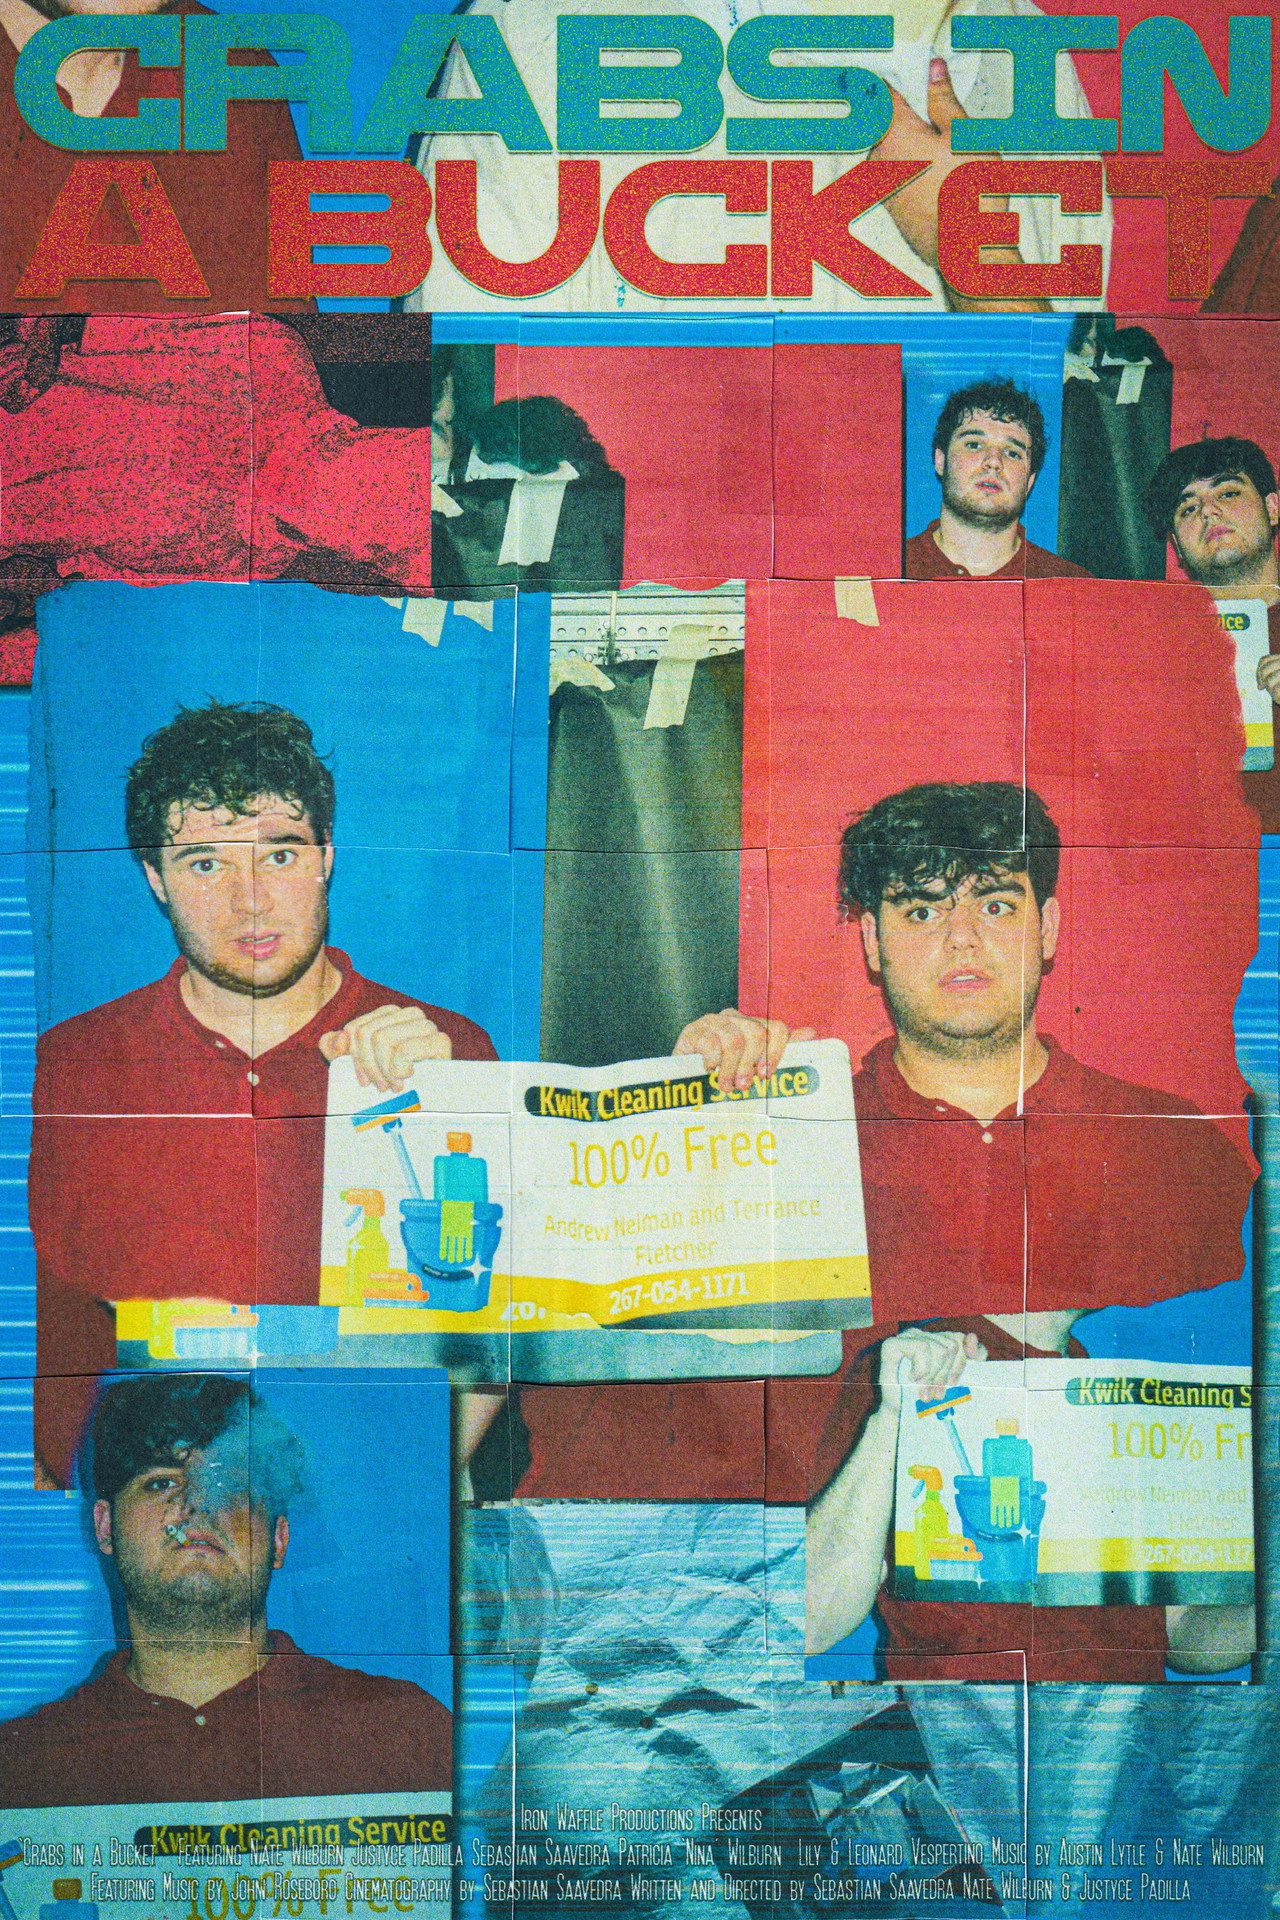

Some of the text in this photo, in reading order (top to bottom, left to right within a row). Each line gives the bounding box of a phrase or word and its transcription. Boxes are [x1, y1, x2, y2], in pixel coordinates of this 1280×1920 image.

[14, 14, 1272, 153] CRABS IN
[13, 160, 1273, 300] A BUCKET
[539, 1085, 592, 1121] Kwik
[597, 1078, 703, 1120] Cleaning
[568, 1125, 778, 1189] 100% Free
[543, 1197, 822, 1242] Andrew Neiman and Terrance
[634, 1238, 718, 1266] Fletcher
[609, 1272, 749, 1316] 267-054-1171
[1078, 1376, 1134, 1405] Kwik
[1140, 1379, 1234, 1412] Cleaning
[1107, 1421, 1203, 1461] 100%
[151, 1814, 446, 1855] Kwik Cleaning Service
[520, 1802, 762, 1831] IRON WAFFLE PRODUCTIONS PRESENTS
[72, 1843, 84, 1866] IN
[92, 1843, 102, 1866] A
[177, 1837, 242, 1866] FEATURING
[250, 1837, 284, 1866] NATE
[291, 1837, 344, 1866] WILBURN
[351, 1837, 406, 1866] JUSTYCE
[413, 1837, 464, 1866] PADILLA
[472, 1837, 537, 1866] SEBASTIAN
[545, 1837, 611, 1866] SAAVEDRA
[618, 1837, 673, 1866] PATRICIA
[728, 1837, 782, 1866] WILBURN
[799, 1837, 821, 1866] LILY
[830, 1837, 839, 1866] &
[848, 1837, 903, 1866] LEONARD
[911, 1837, 983, 1866] VESPERTINO
[991, 1837, 1026, 1866] MUSIC
[1035, 1843, 1051, 1866] BY
[1059, 1837, 1103, 1866] AUSTIN
[1110, 1837, 1146, 1866] LYTLE
[1155, 1837, 1164, 1866] &
[1173, 1837, 1202, 1866] NATE
[1211, 1837, 1264, 1866] WILBURN
[91, 1872, 1192, 1901] FEATURING MUSIC BY JOHN ROSEBORO CINEMATOGRAPHY BY SEBASTIAN SAAVEDRA WRITTEN AND DIRECTED BY SEBASTIAN SAAVEDRA NATE WILBURN & JUSTYCE PADILLA
